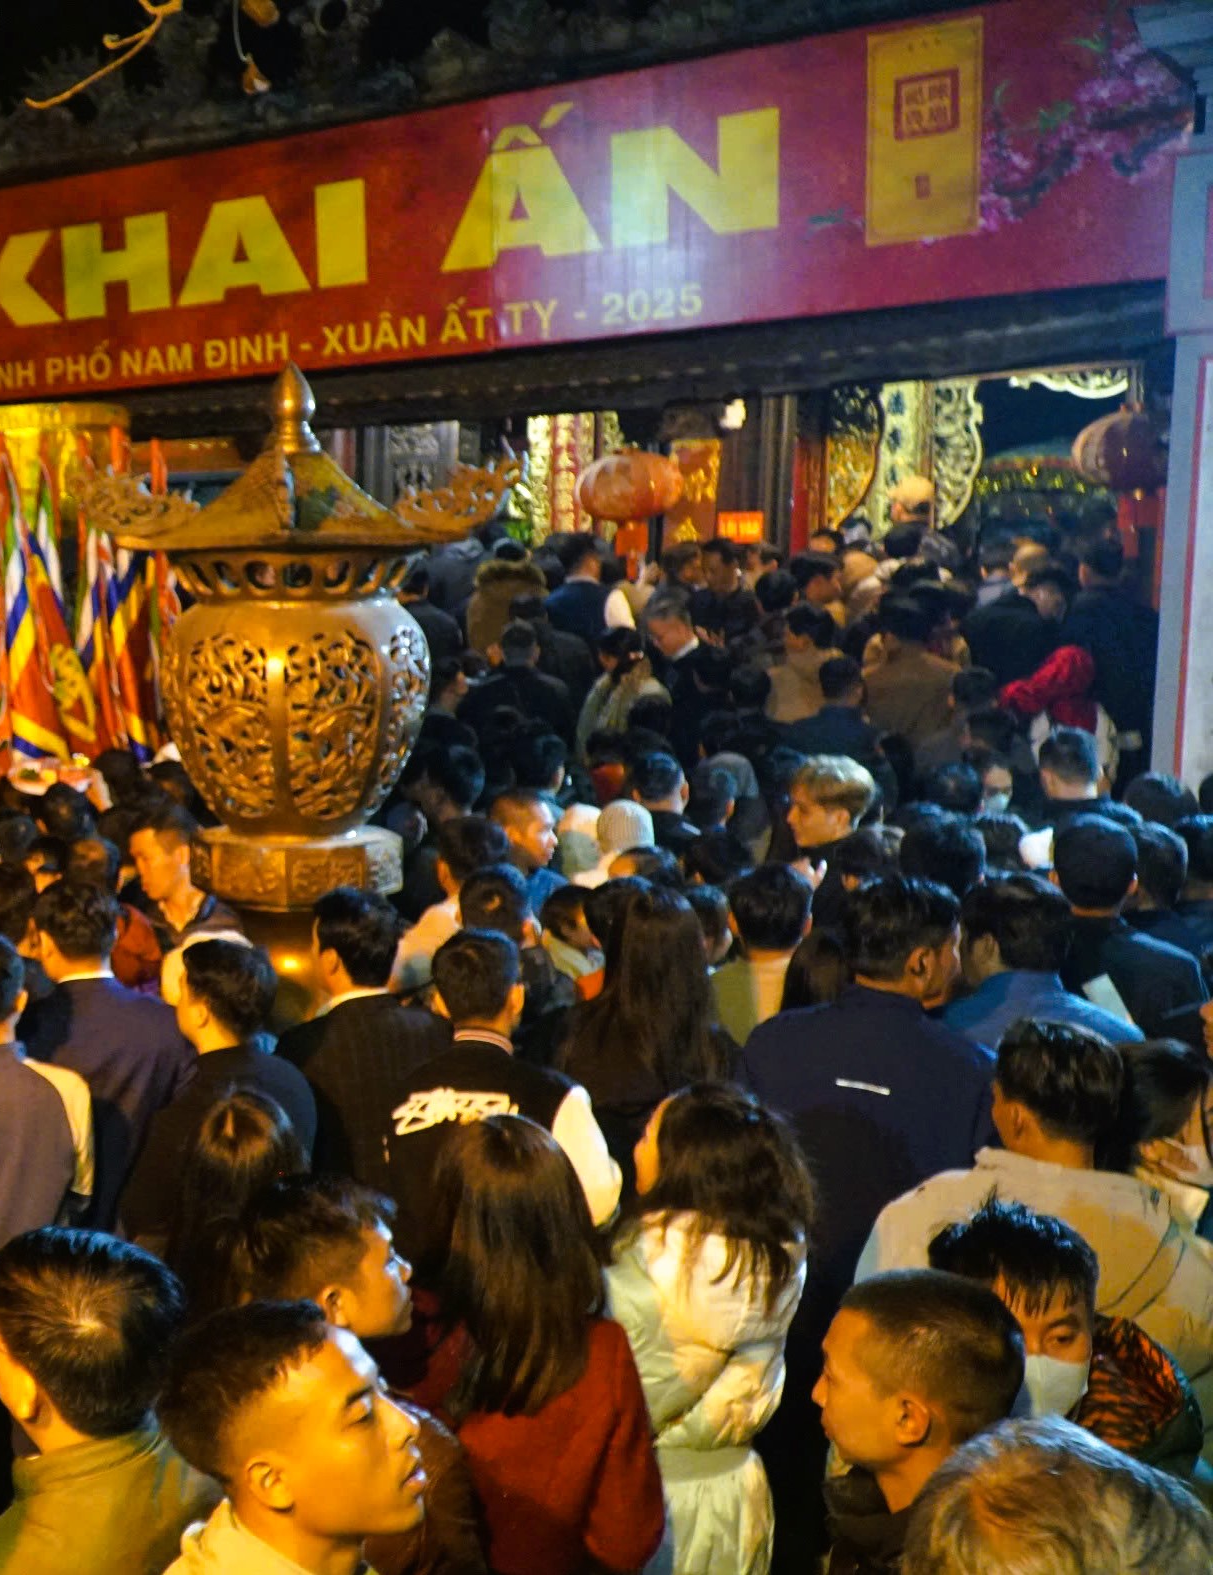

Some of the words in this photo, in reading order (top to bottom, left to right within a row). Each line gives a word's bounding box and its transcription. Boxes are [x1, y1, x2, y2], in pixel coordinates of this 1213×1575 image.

[440, 101, 780, 273] ẤN
[45, 340, 112, 386] PHỐ
[120, 342, 194, 378] NAM
[204, 331, 288, 373] ĐỊNH
[322, 312, 427, 358] XUÂN
[441, 297, 493, 343] ẤT
[600, 282, 703, 326] 2025
